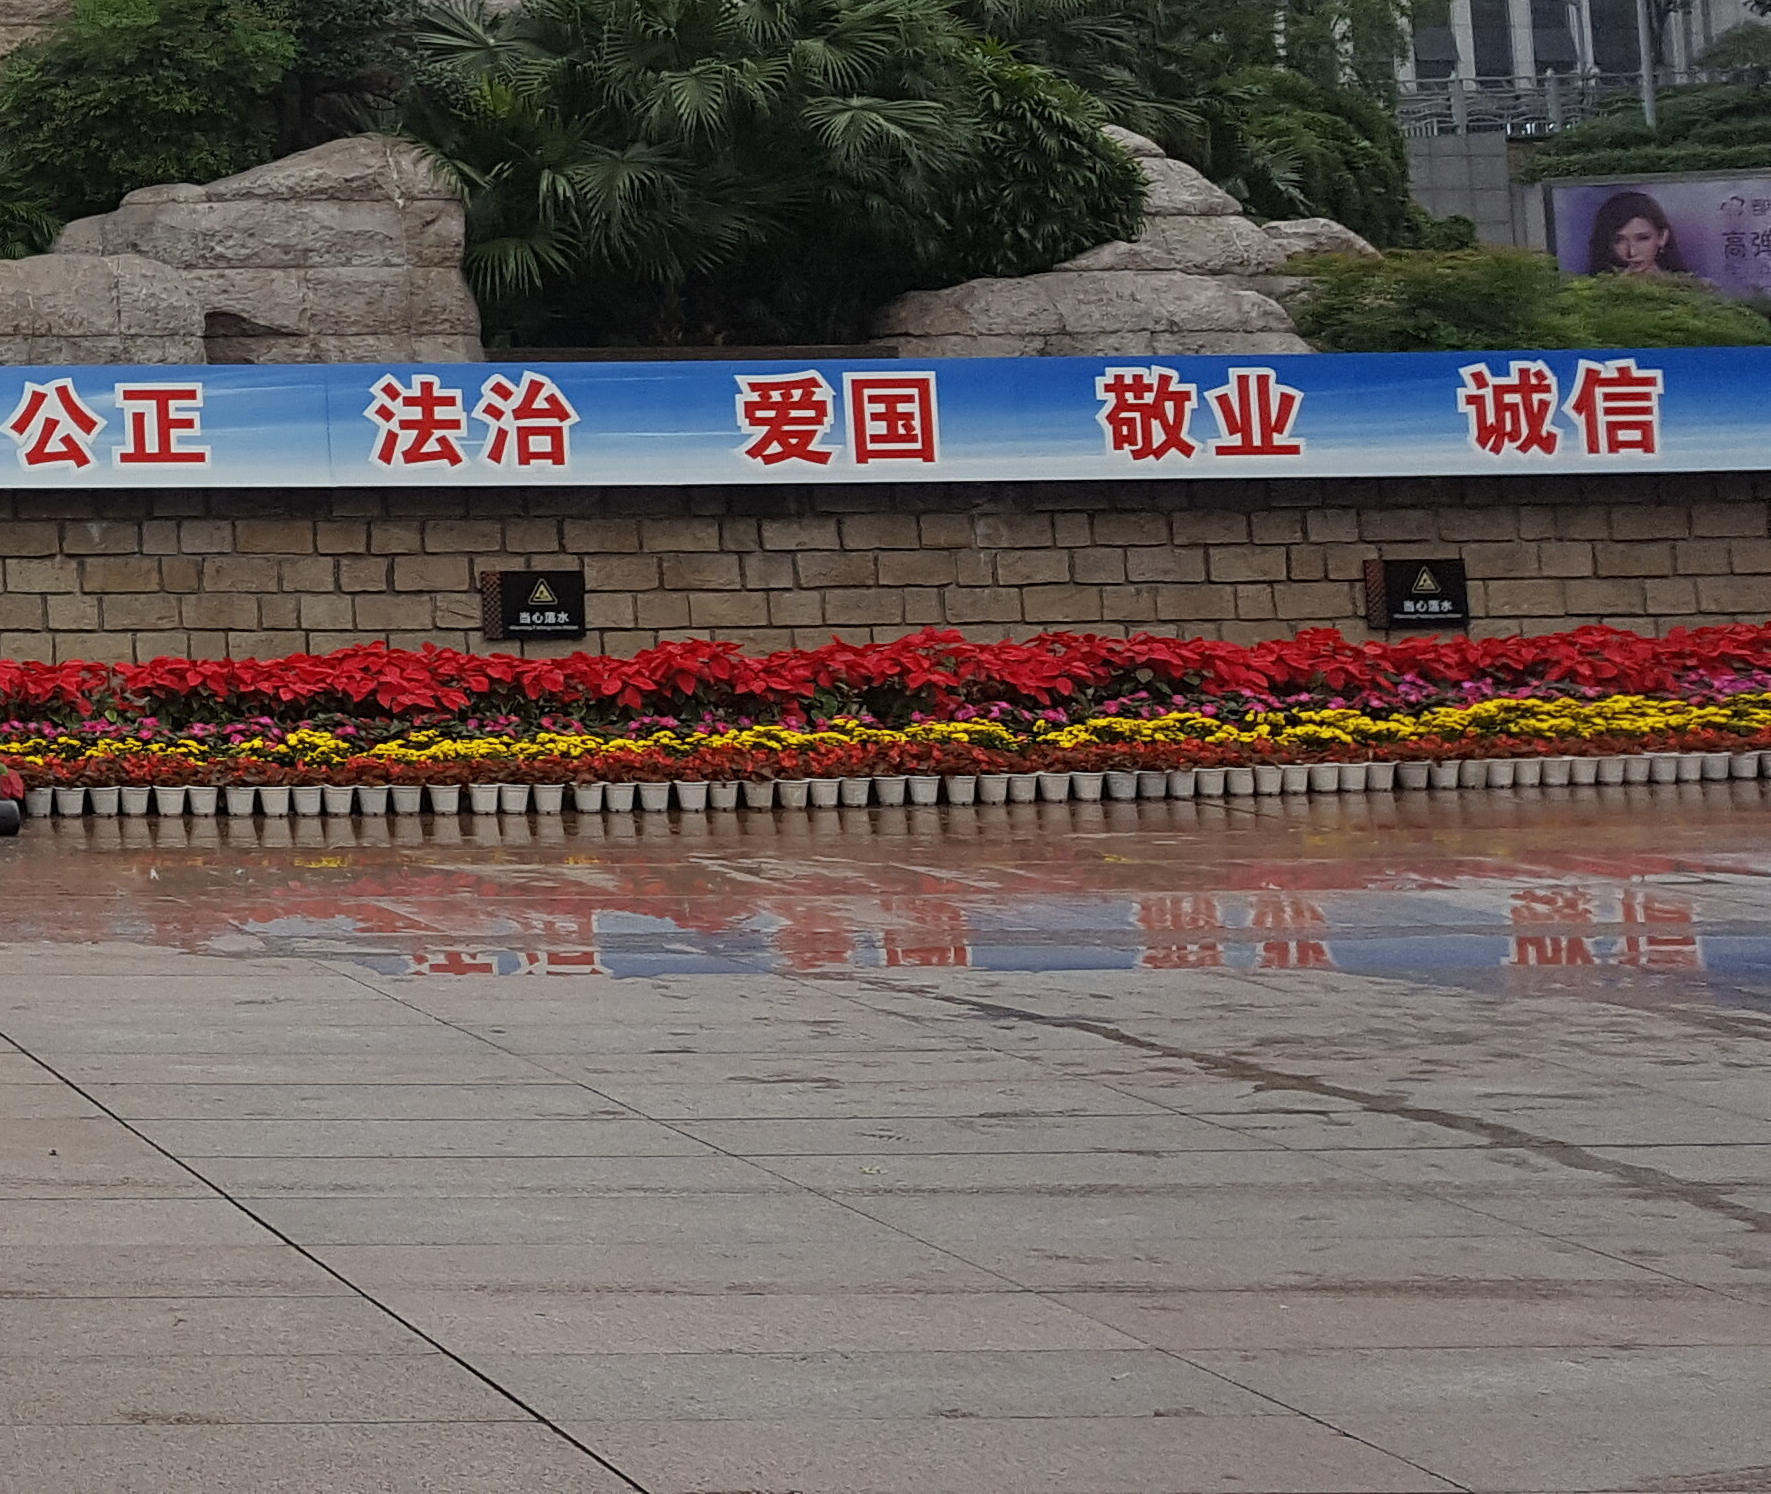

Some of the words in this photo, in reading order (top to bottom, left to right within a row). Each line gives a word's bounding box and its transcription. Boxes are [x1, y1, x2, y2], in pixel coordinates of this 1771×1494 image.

[9, 381, 210, 471] 公正
[372, 376, 574, 469] 法治
[741, 373, 939, 468] 爱国
[1102, 371, 1304, 463] 敬业
[1464, 363, 1660, 457] 诚信
